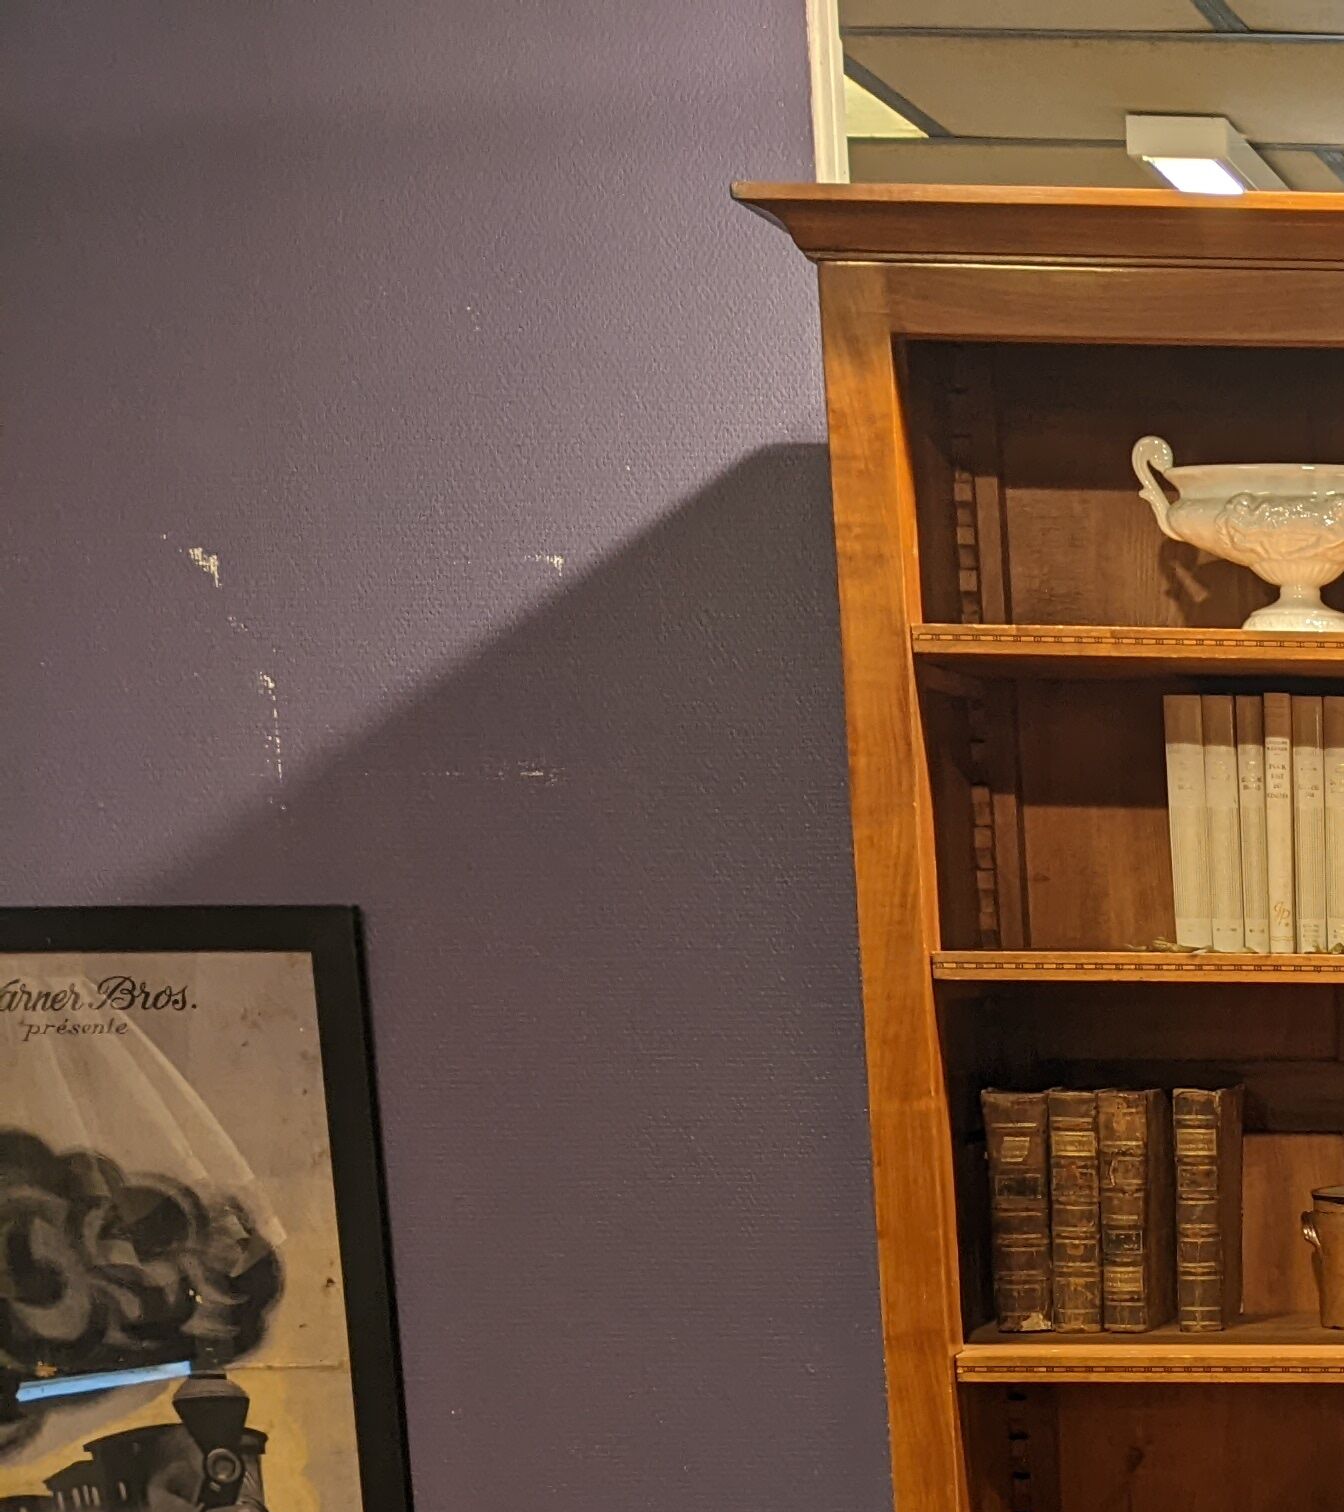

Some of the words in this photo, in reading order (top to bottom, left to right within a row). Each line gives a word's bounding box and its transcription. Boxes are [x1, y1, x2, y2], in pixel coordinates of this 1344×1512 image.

[0, 978, 84, 1012] arner
[88, 975, 197, 1011] Bros.
[20, 1017, 129, 1042] présente
